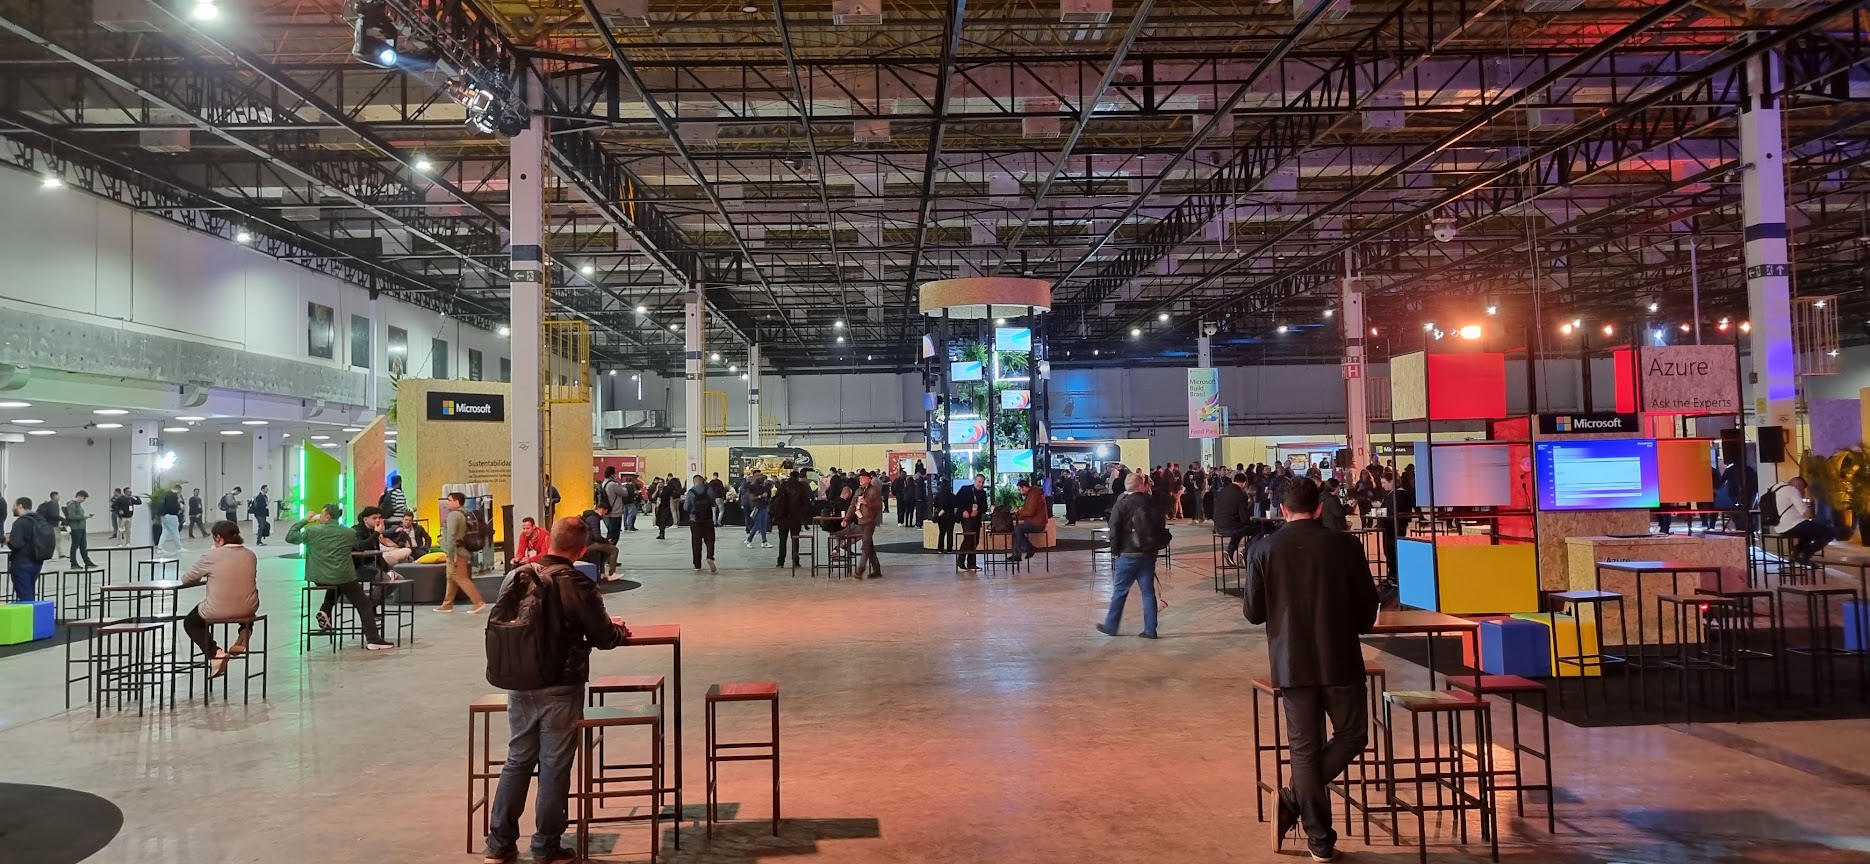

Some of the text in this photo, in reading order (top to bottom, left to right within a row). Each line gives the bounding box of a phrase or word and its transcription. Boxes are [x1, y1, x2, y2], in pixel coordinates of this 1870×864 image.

[1348, 366, 1358, 378] H
[1648, 358, 1708, 377] Azure
[456, 403, 491, 414] Microsoft
[1652, 398, 1732, 410] Ask the Experts
[1574, 417, 1622, 428] Microsoft
